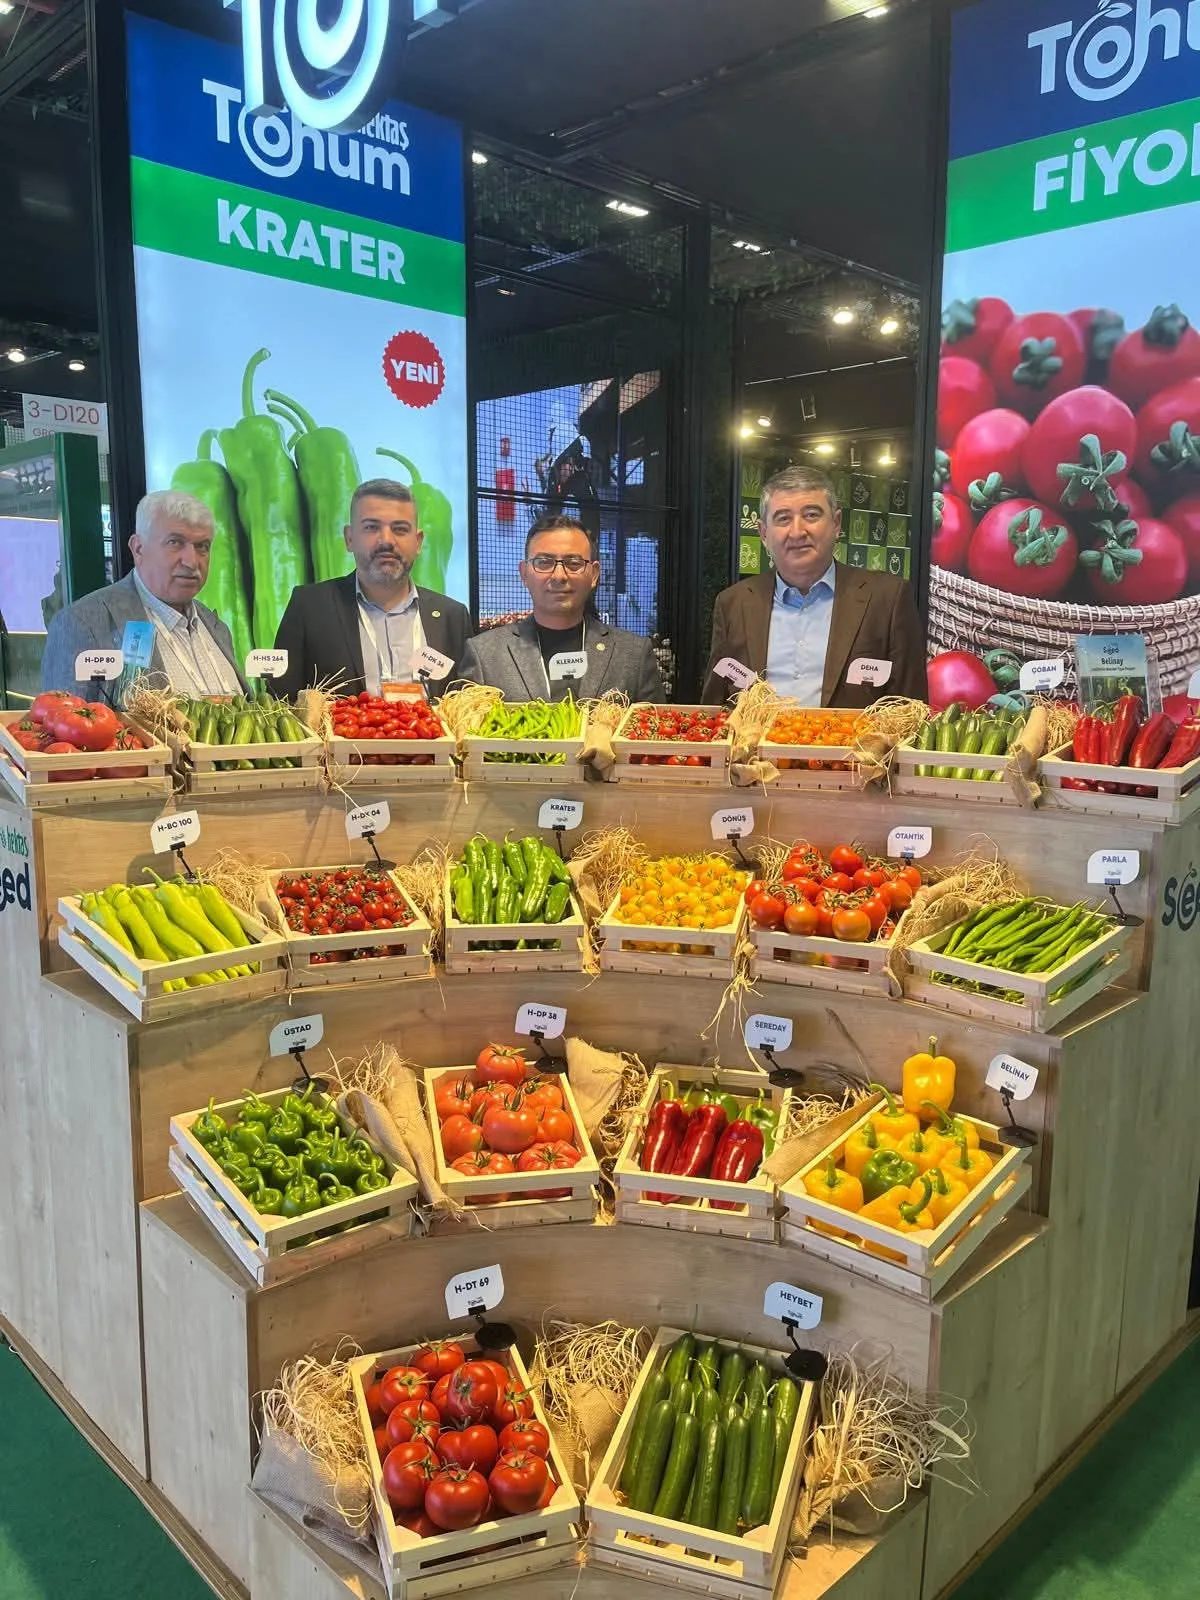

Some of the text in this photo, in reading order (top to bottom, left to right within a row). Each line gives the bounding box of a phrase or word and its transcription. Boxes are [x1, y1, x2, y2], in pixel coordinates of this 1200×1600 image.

[1033, 124, 1200, 211] FİYO
[217, 198, 406, 285] KRATER
[390, 358, 439, 385] YENİ
[27, 400, 100, 425] 3-D120
[105, 656, 115, 664] 80
[556, 657, 584, 665] KLERANS
[860, 664, 879, 672] DEHA
[1031, 665, 1057, 674] ÇOBAN
[550, 803, 576, 812] KRATER
[157, 817, 192, 833] H-BC 100
[895, 832, 925, 841] OTANTİK
[1161, 866, 1200, 932] Se
[527, 1008, 557, 1020] H-DP 38
[283, 1023, 312, 1036] ÜSTAD
[754, 1020, 787, 1032] SEREDAY
[1000, 1061, 1030, 1081] BELİNAY
[454, 1276, 490, 1294] H-DT 69
[780, 1290, 814, 1309] HEYBET
